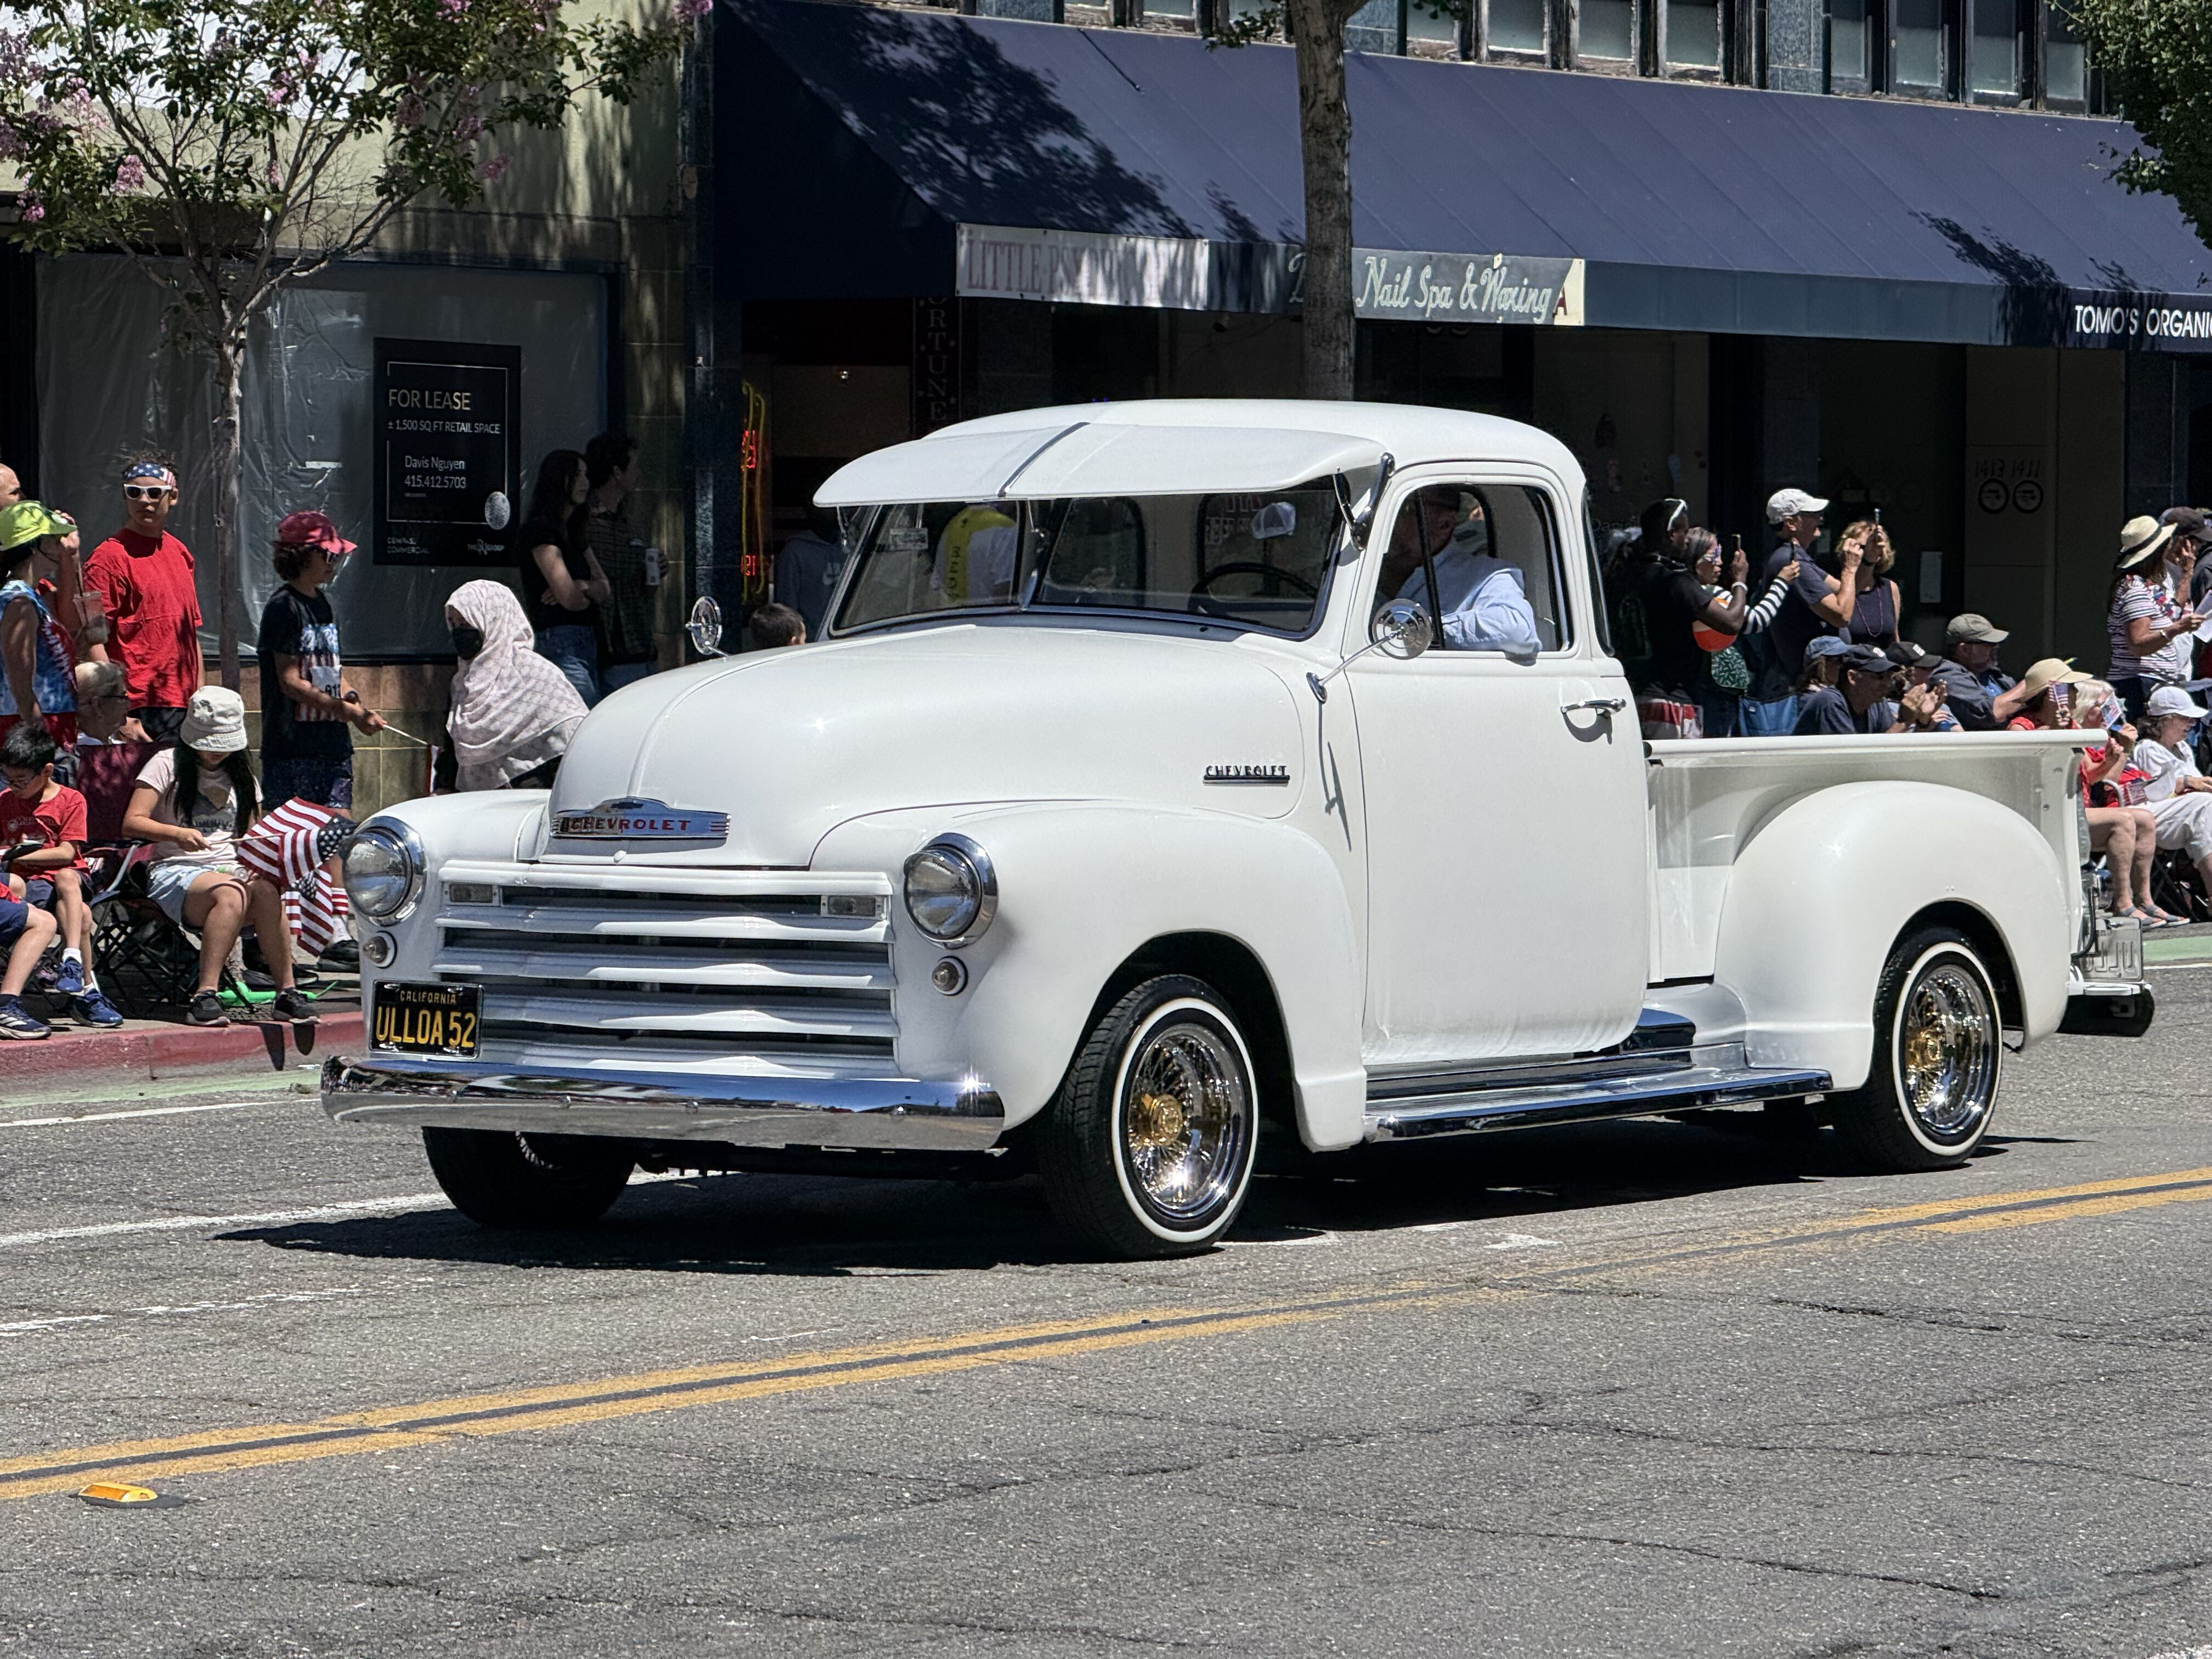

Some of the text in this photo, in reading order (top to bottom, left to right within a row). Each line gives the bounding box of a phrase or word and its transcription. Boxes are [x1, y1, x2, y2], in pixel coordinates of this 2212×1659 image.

[967, 238, 1042, 294] LITTLE
[1355, 256, 1412, 308] Nail
[1414, 265, 1453, 318] Spa
[1459, 262, 1478, 309] &
[1480, 267, 1553, 324] Waxing
[2075, 305, 2212, 338] TOMO'S ORGANI
[388, 389, 471, 410] FOR LEASE
[395, 419, 418, 431] 1,500
[419, 420, 432, 432] SQ
[433, 421, 444, 431] FT
[445, 421, 473, 433] RETAIL
[474, 422, 500, 434] SPACE
[405, 455, 465, 471] Davis Nguyen
[404, 475, 466, 489] 415.412.5703
[1206, 765, 1287, 776] CHEVROLET
[571, 816, 691, 831] CHEVROLET
[399, 990, 456, 1005] CALIFORNIA
[376, 1006, 476, 1048] ULLOA 52
